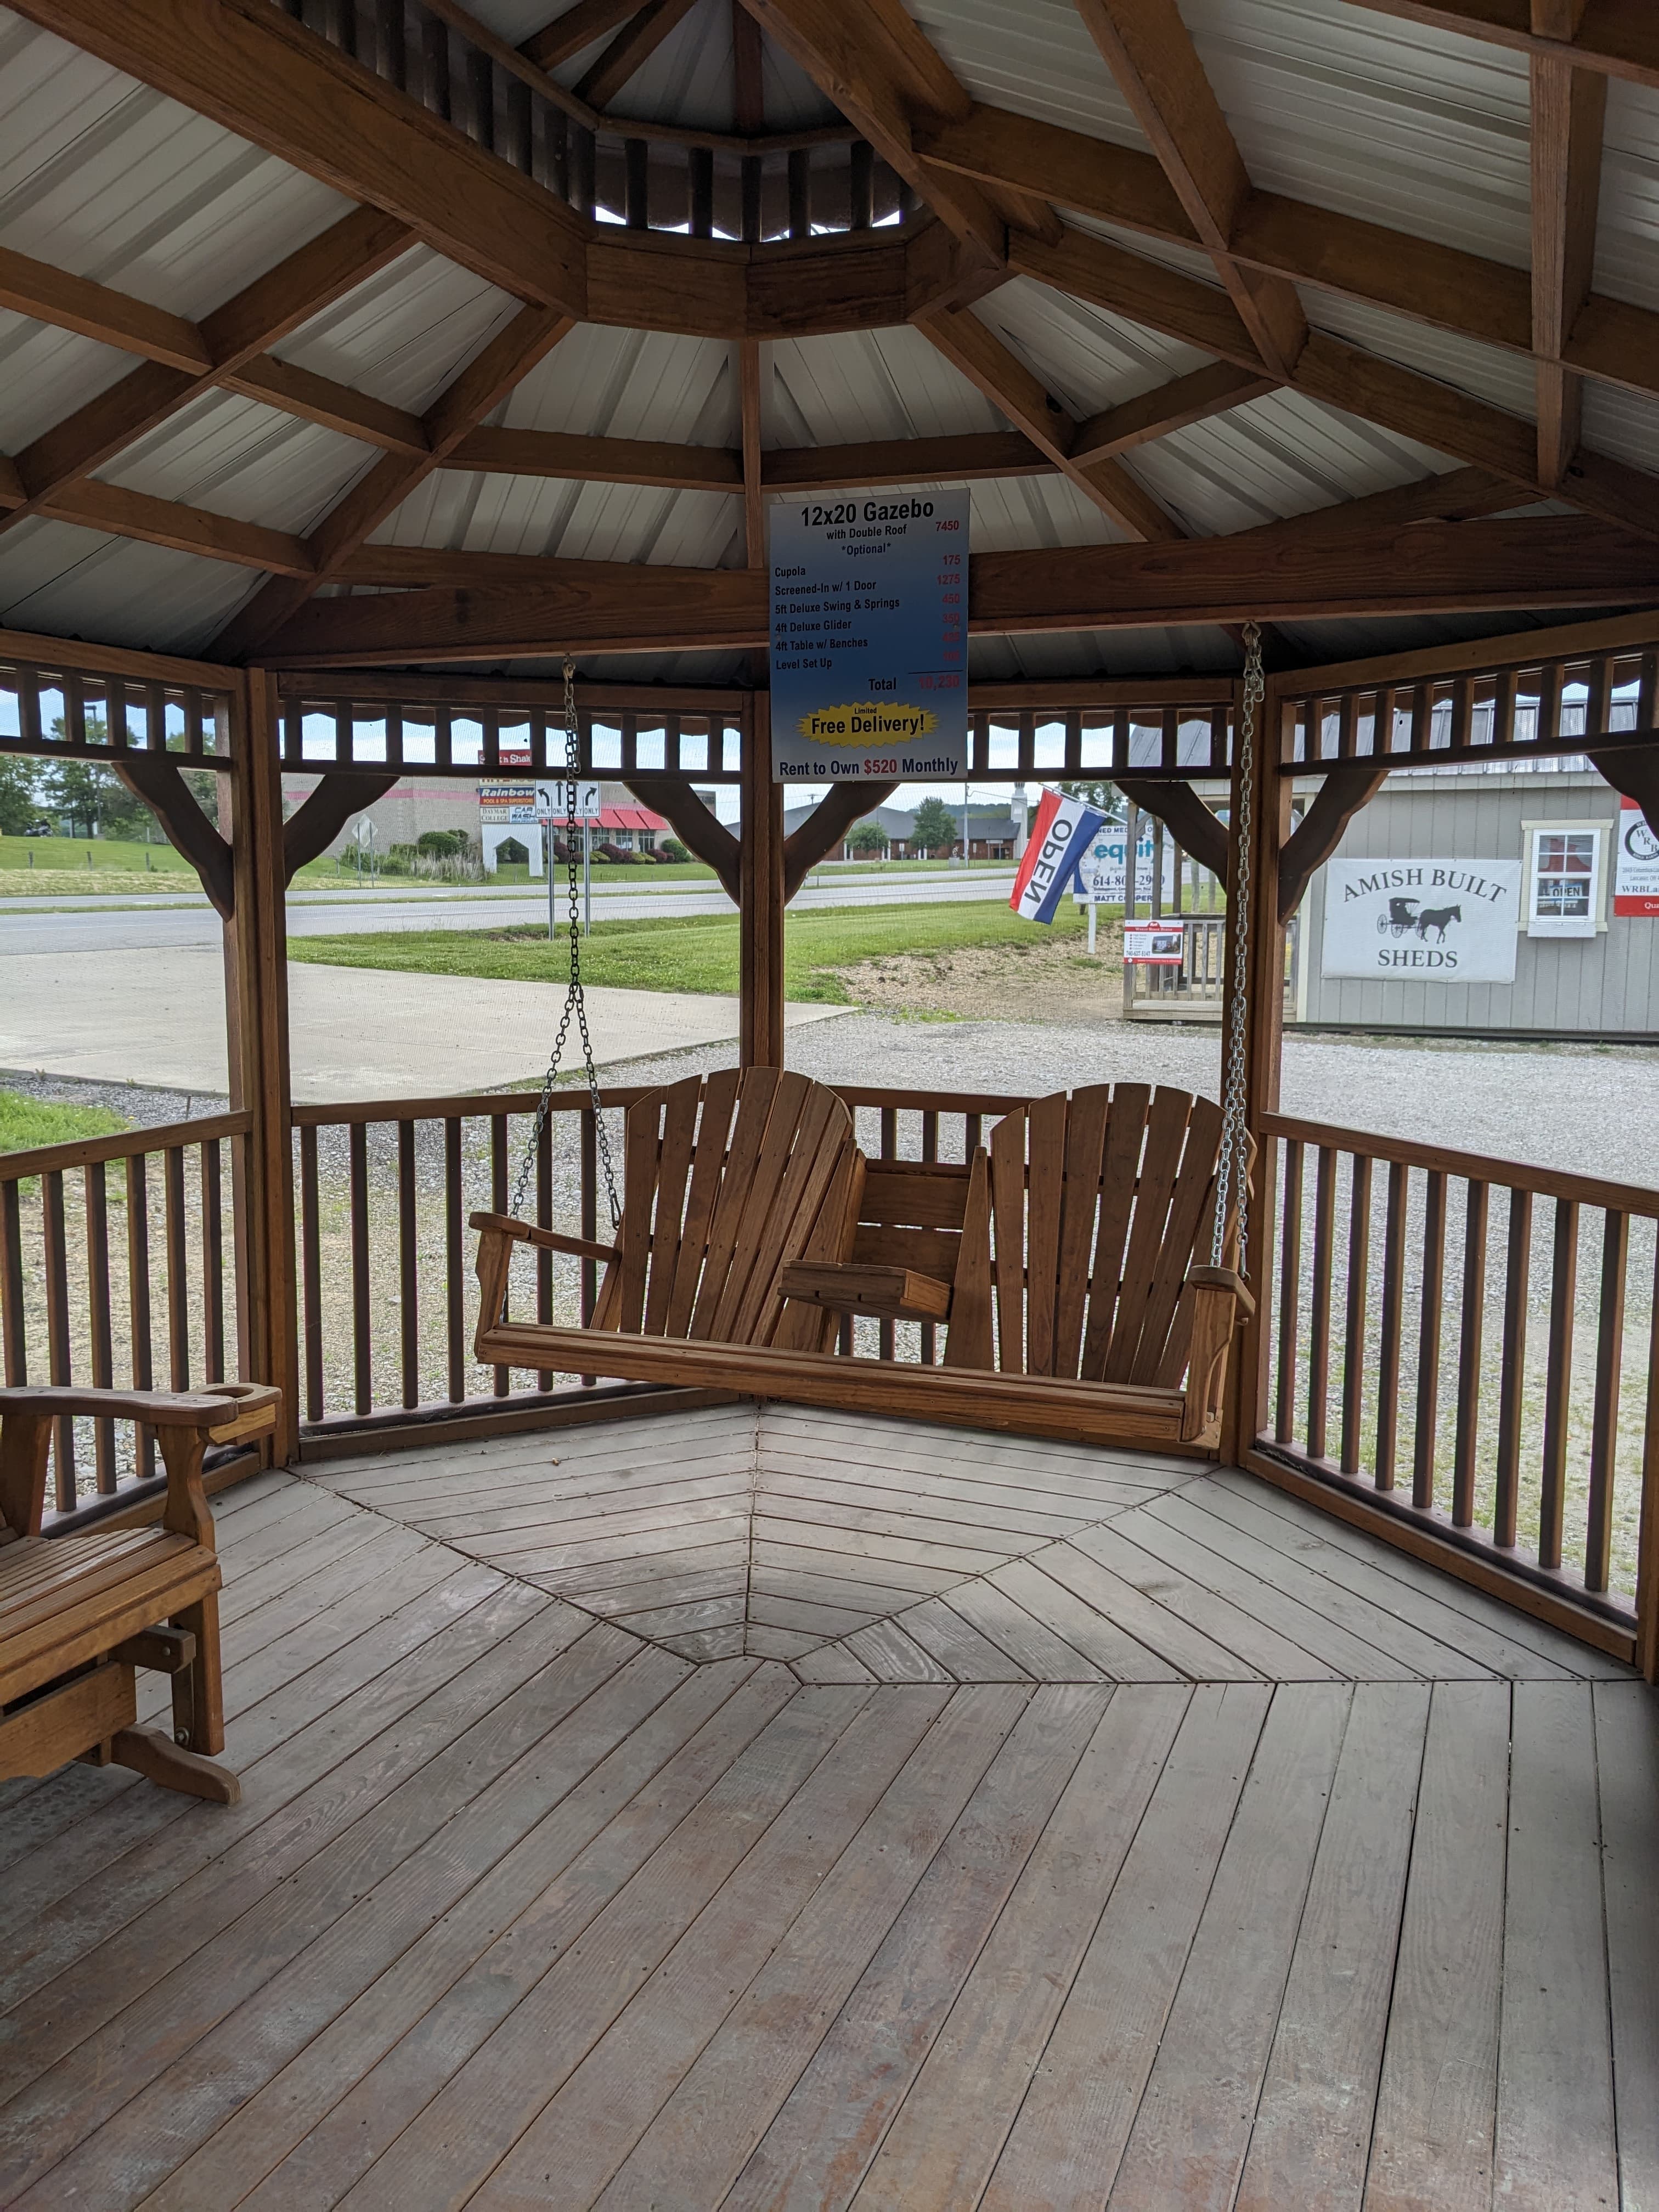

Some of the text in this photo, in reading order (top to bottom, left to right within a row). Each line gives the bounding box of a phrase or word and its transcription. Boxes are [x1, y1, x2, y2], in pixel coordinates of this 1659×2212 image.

[801, 500, 933, 527] 12x20 Gazebo
[827, 524, 906, 540] with Double Roof
[935, 521, 959, 531] 7450
[943, 555, 960, 565] 175
[775, 567, 806, 579] Cupola
[937, 574, 960, 585] 1275
[775, 581, 876, 596] Screened-In w/ 1 Door
[942, 594, 960, 603] 450
[775, 598, 899, 614] 5ft Deluxe Swing & Springs
[776, 620, 851, 633] 4ft Deluxe Glider
[776, 637, 868, 651] 4ft Table w/ Benches
[776, 658, 832, 670] Level Set Up
[868, 675, 960, 691] Total 10,230
[811, 714, 924, 735] Free Delivery!
[510, 754, 531, 764] Shak
[780, 758, 958, 776] Rent to Own $520 Monthly
[482, 788, 534, 797] Rainbow
[1343, 868, 1506, 902] AMISH BUILT
[1553, 886, 1580, 896] OPEN
[1378, 950, 1458, 968] SHEDS
